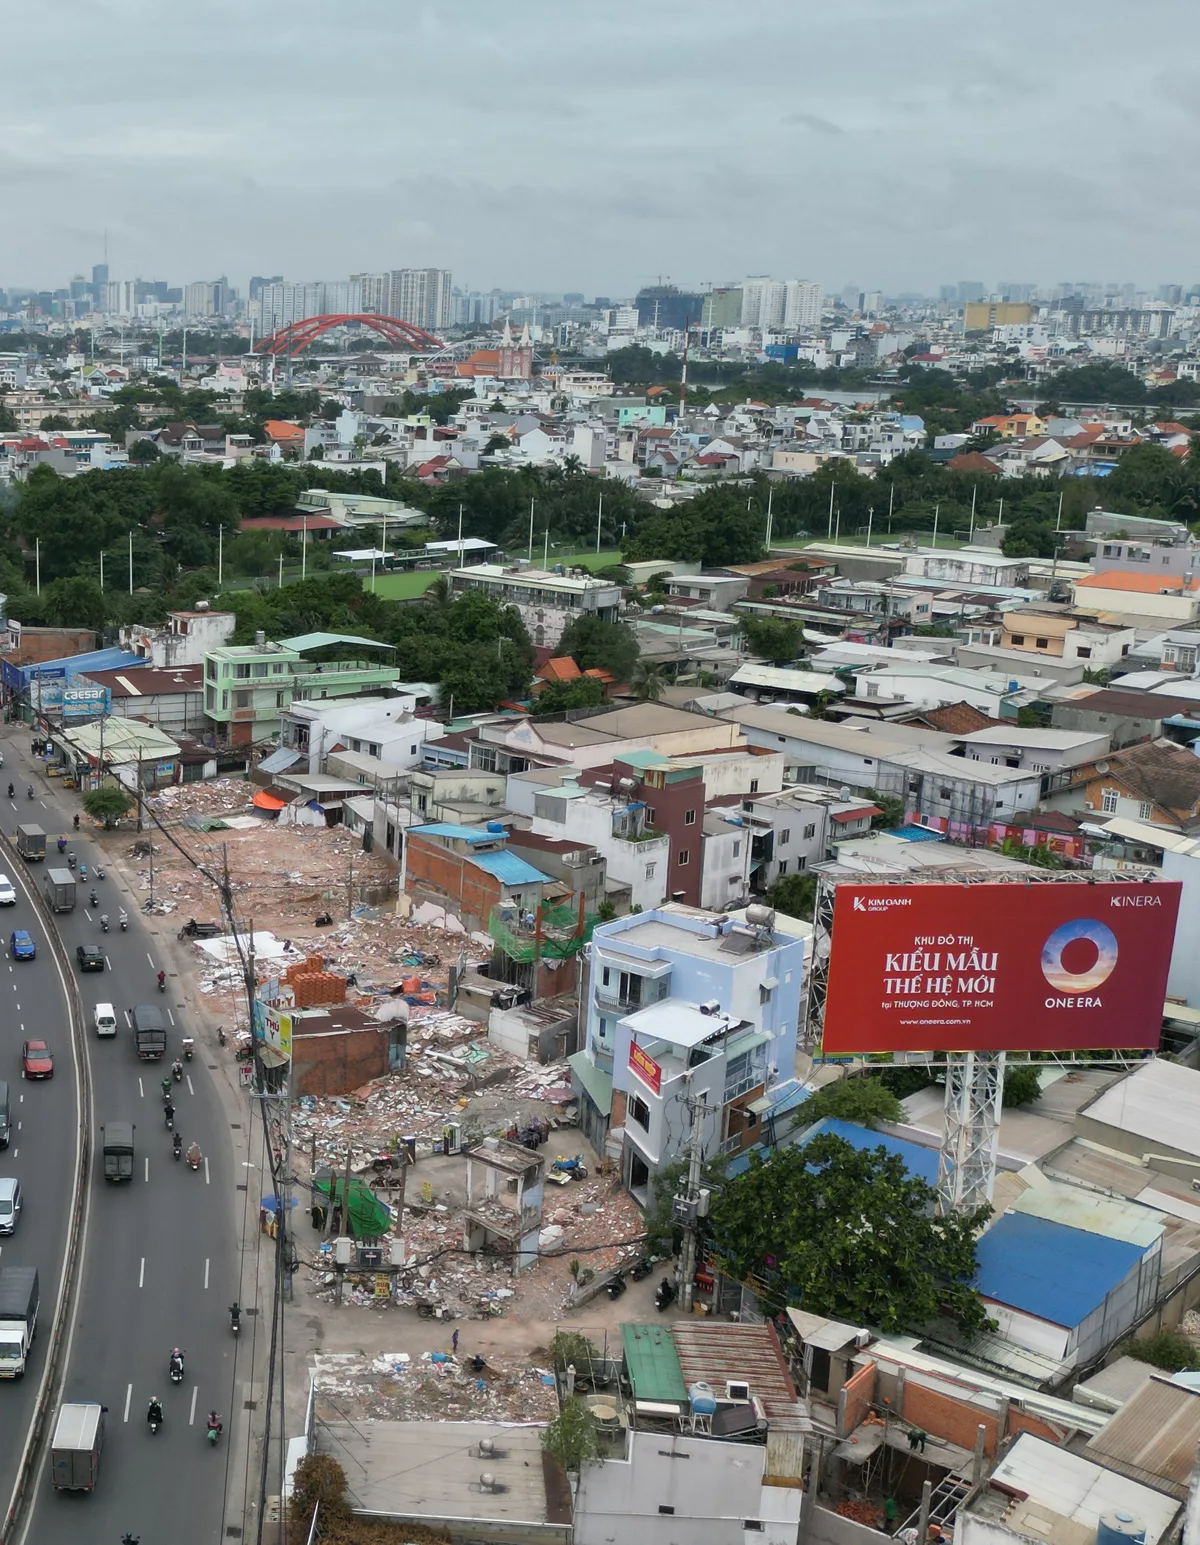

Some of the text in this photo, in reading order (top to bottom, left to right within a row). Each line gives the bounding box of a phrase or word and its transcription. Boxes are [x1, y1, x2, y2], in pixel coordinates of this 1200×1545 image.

[64, 689, 105, 700] caesar
[868, 898, 912, 906] KIM OANH
[1110, 895, 1162, 907] KINERA
[914, 933, 974, 947] KHU ĐÔ THỊ
[884, 946, 999, 972] KIỂU MẪU
[883, 973, 996, 996] THẾ HỆ MỚI
[881, 1001, 892, 1010] tại
[974, 1000, 994, 1008] HCM
[1044, 997, 1102, 1009] ONE ERA
